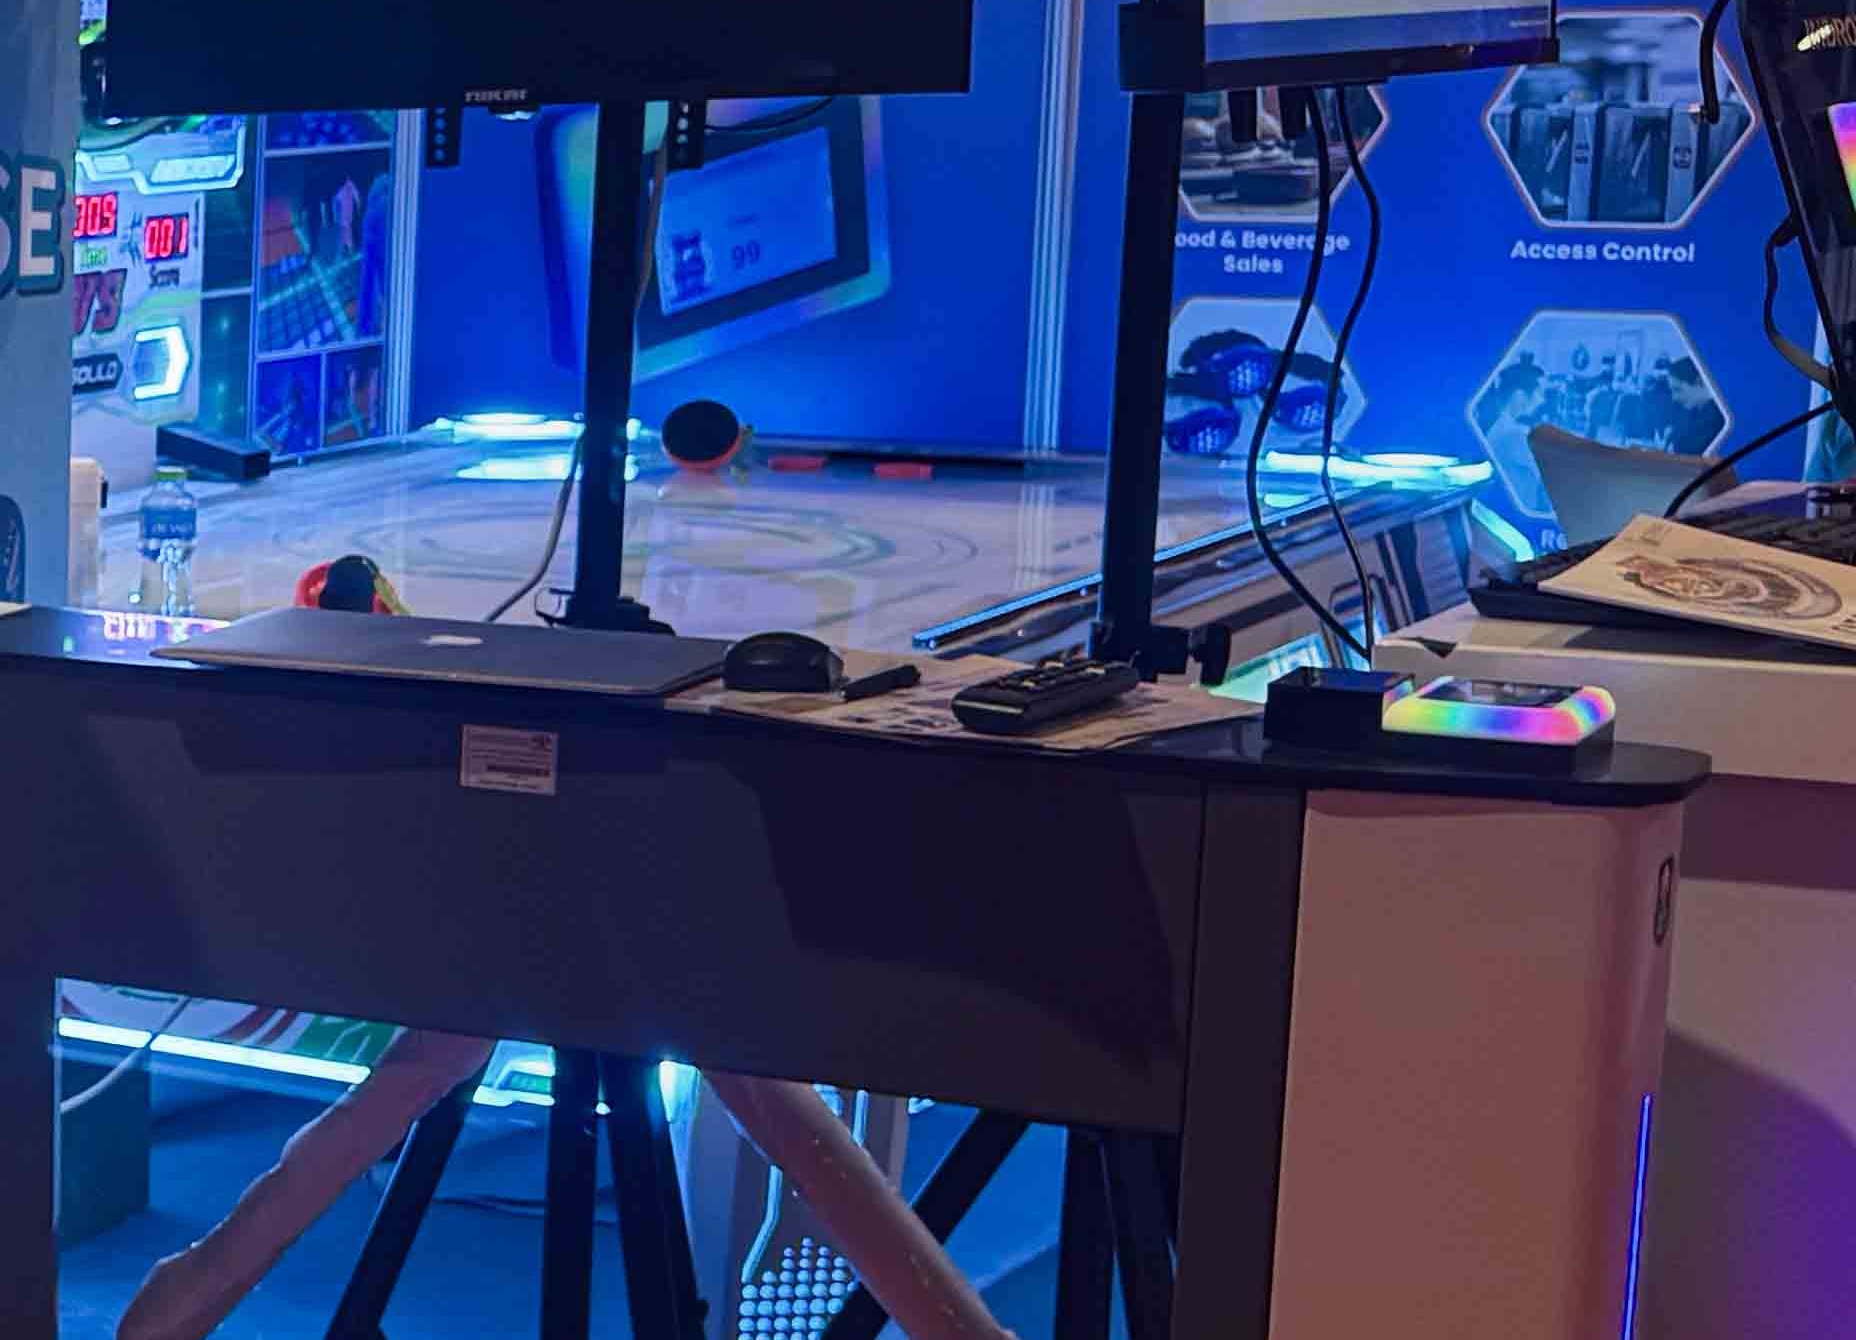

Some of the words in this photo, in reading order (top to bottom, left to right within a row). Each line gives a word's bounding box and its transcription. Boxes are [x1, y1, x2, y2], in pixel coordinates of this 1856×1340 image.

[145, 215, 188, 261] 001
[1174, 229, 1216, 248] ood
[1219, 230, 1237, 249] &
[1510, 239, 1597, 260] Access
[1602, 242, 1696, 263] Control
[1223, 254, 1284, 274] Sales
